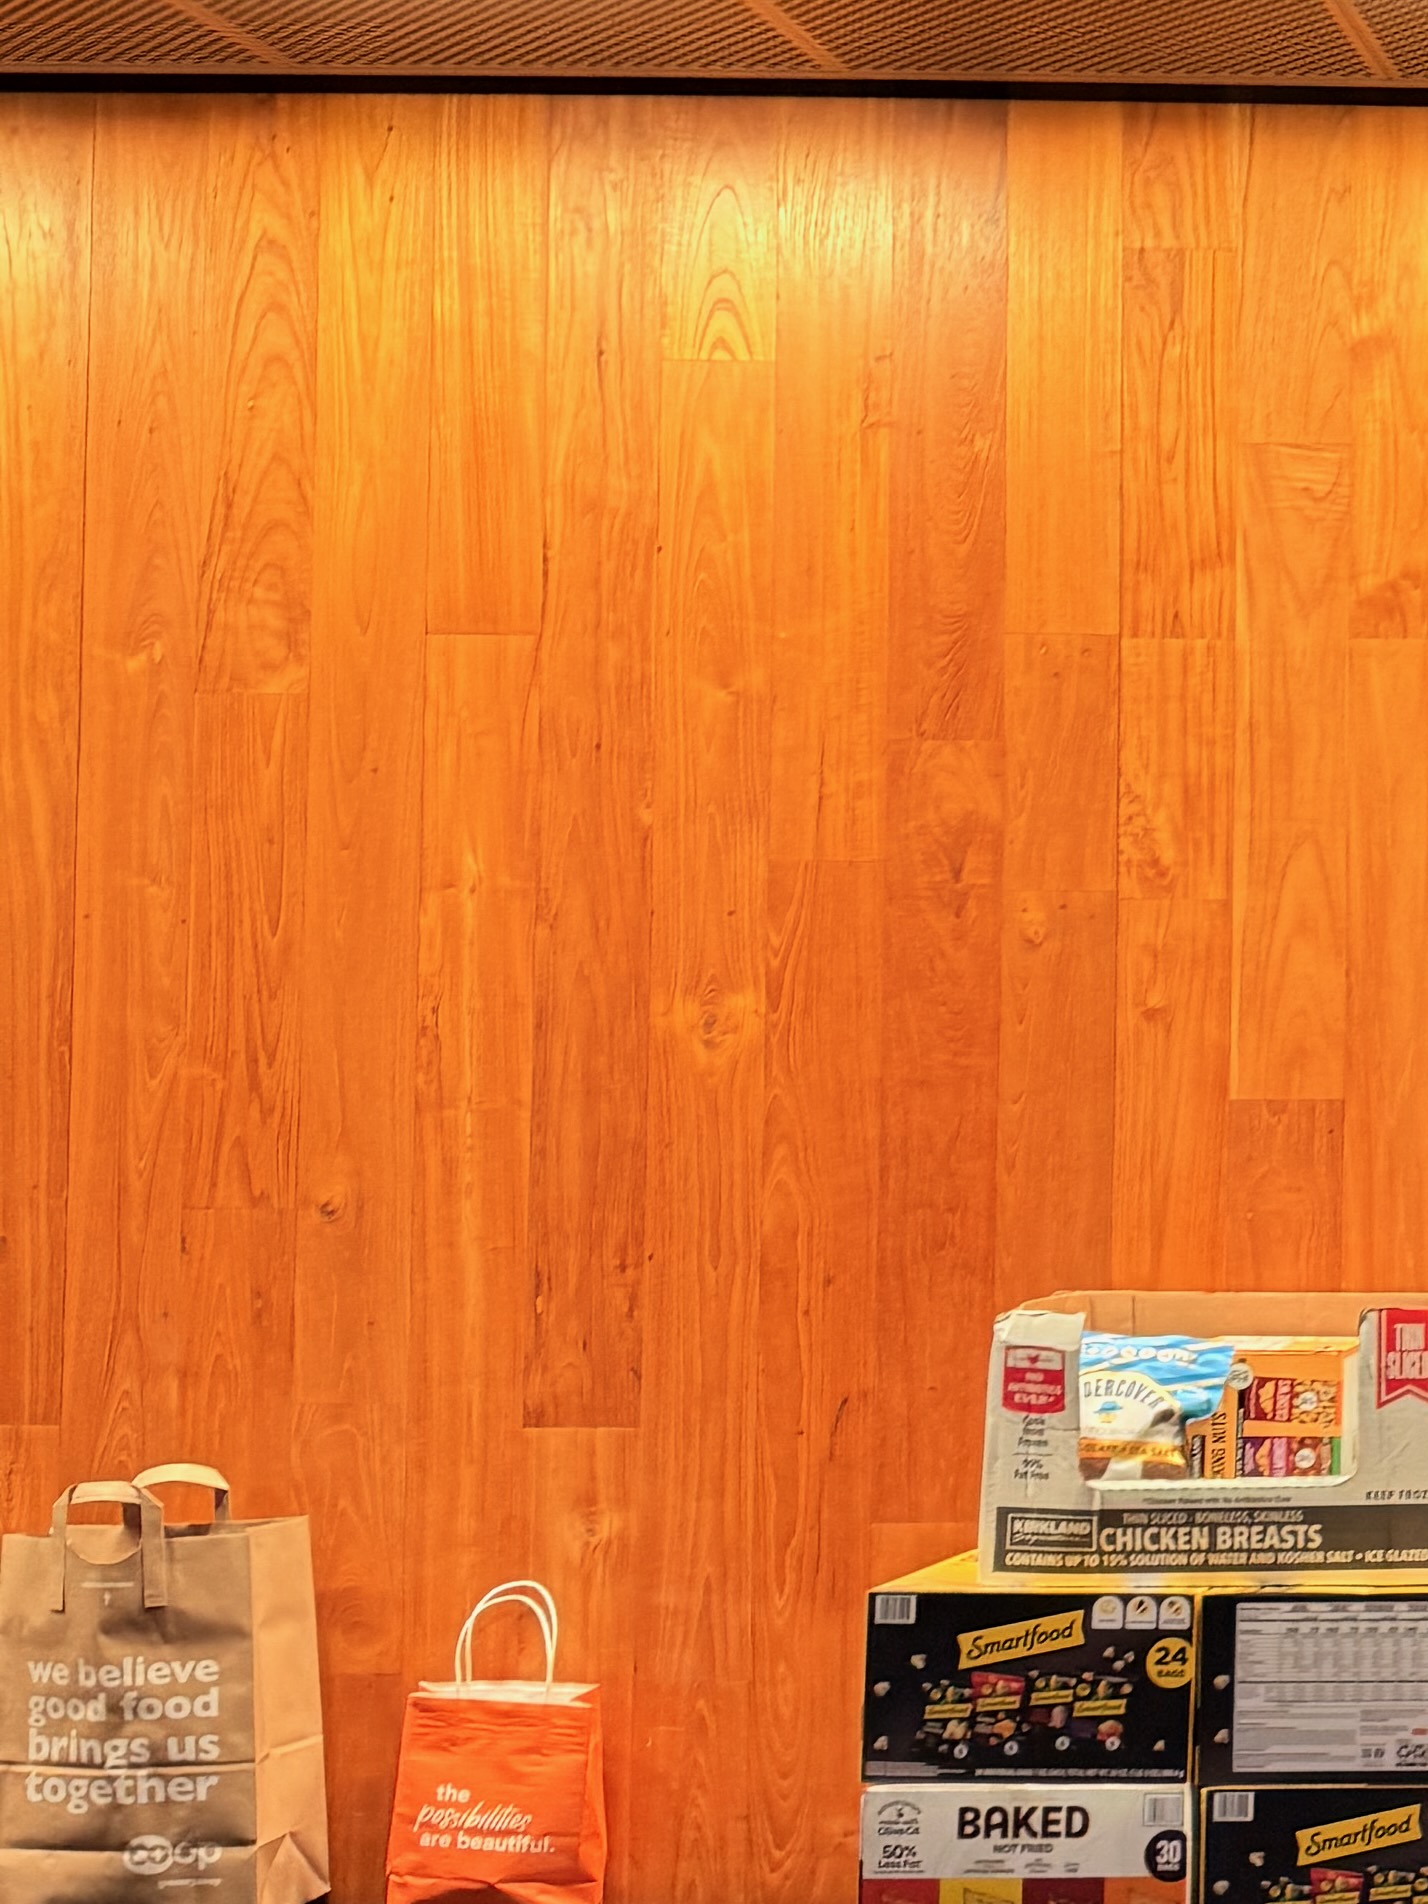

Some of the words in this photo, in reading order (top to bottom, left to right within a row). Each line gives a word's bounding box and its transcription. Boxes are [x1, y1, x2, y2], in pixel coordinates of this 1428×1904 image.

[1083, 1378, 1166, 1410] DERCOVER
[1012, 1519, 1091, 1535] KIRKLAND
[1100, 1526, 1209, 1552] CHICKEN
[1215, 1523, 1323, 1550] BREASTS
[1004, 1552, 1063, 1567] CONTAINS
[1129, 1552, 1188, 1567] SOLUTION
[966, 1621, 1074, 1660] Smartfood
[1154, 1646, 1188, 1666] 24
[27, 1659, 70, 1686] we
[78, 1656, 219, 1688] believe
[28, 1693, 107, 1727] good
[120, 1687, 219, 1721] food
[28, 1727, 150, 1775] brings
[166, 1733, 219, 1762] us
[24, 1770, 219, 1814] together
[436, 1783, 471, 1803] the
[412, 1800, 533, 1833] possibilities
[957, 1805, 1090, 1840] BAKED
[419, 1832, 452, 1848] are
[456, 1829, 555, 1853] beautiful.
[1305, 1814, 1412, 1856] Smartfood
[1156, 1840, 1181, 1863] 30
